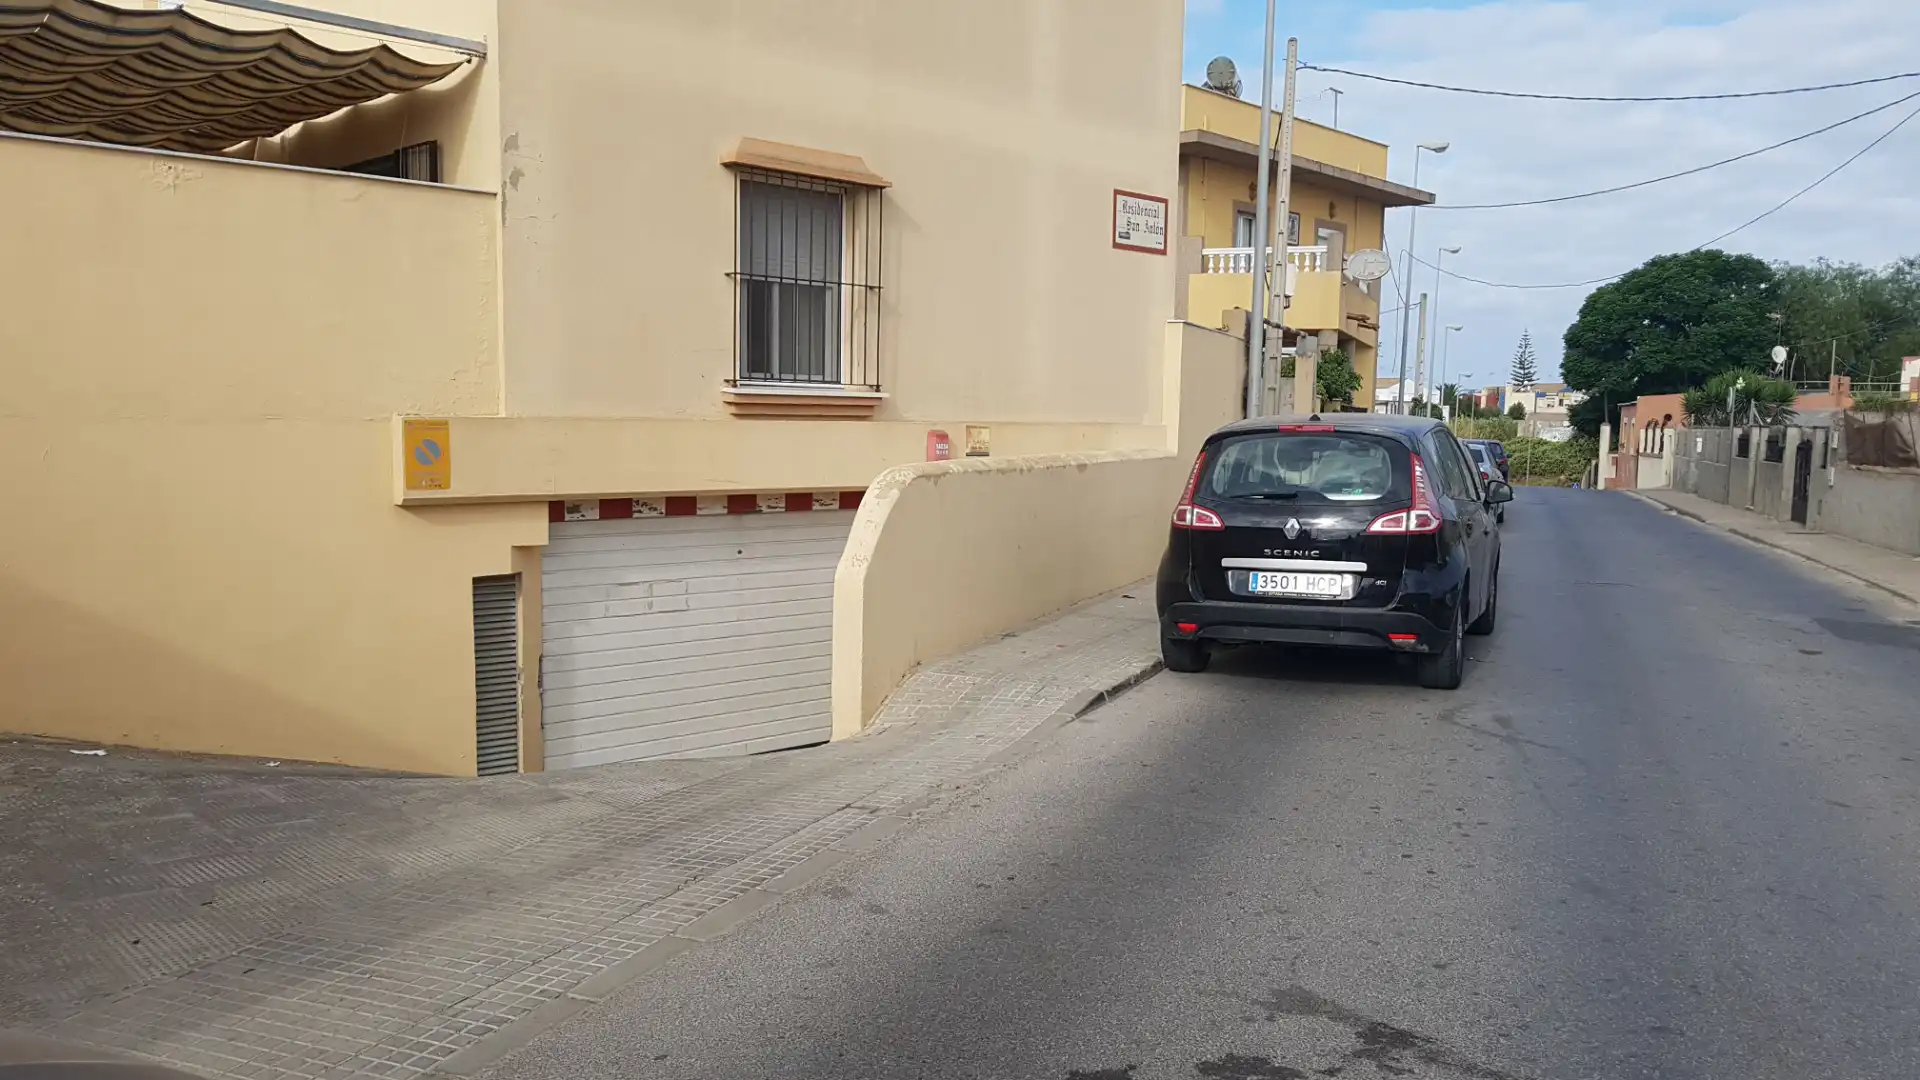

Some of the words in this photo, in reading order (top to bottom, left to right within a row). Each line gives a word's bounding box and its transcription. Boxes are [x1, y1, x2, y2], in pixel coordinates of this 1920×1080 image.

[1121, 199, 1160, 219] Residencial
[1127, 216, 1140, 232] San
[1263, 548, 1320, 558] SCENIC
[1260, 574, 1298, 591] 3501
[1305, 575, 1338, 593] HCP
